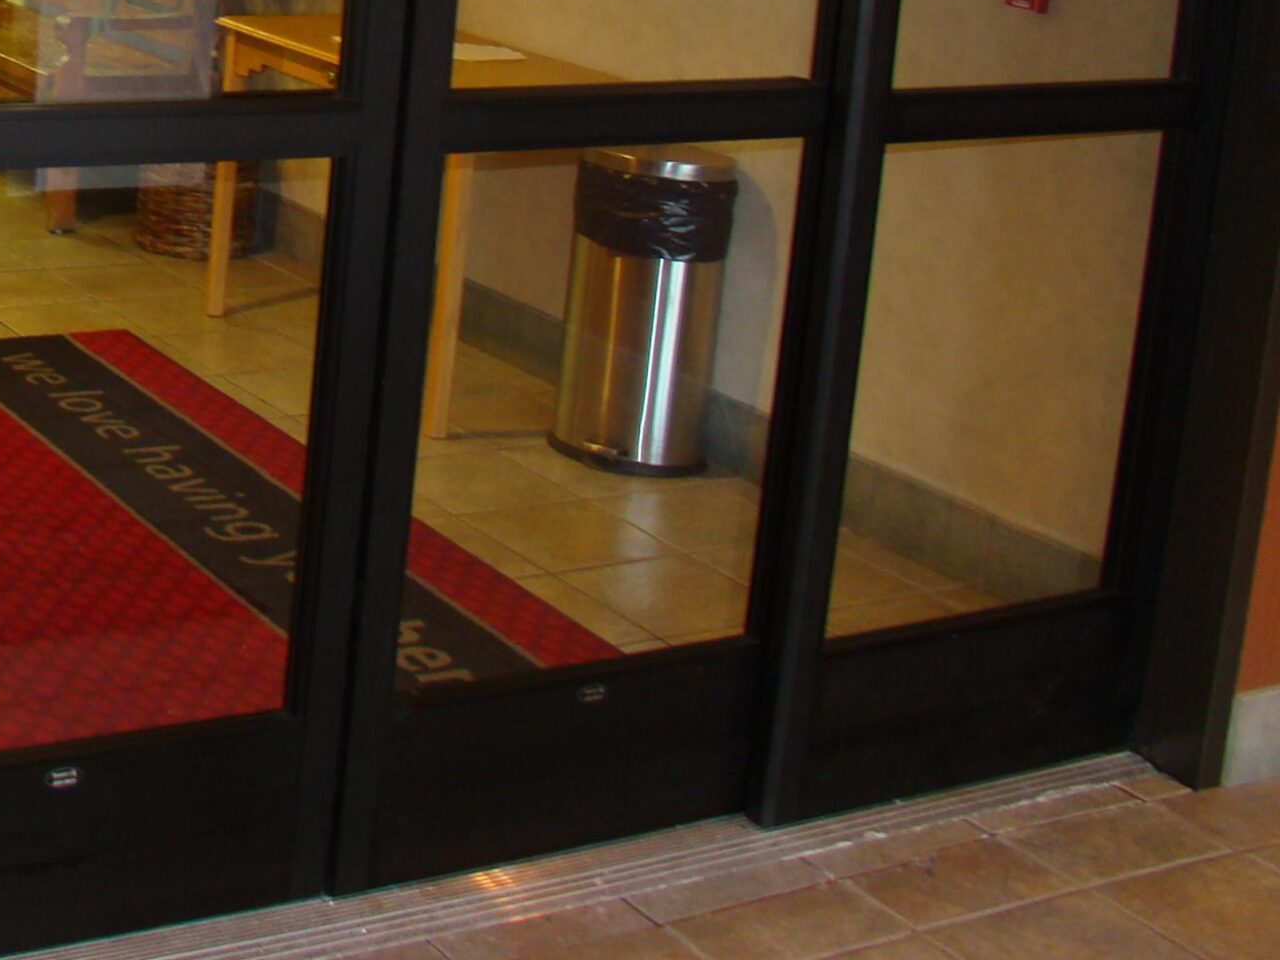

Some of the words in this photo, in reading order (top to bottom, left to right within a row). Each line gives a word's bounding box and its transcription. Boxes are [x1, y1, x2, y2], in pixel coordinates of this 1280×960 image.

[0, 352, 68, 386] we
[47, 389, 141, 440] love
[123, 444, 280, 543] having
[395, 619, 477, 683] her
